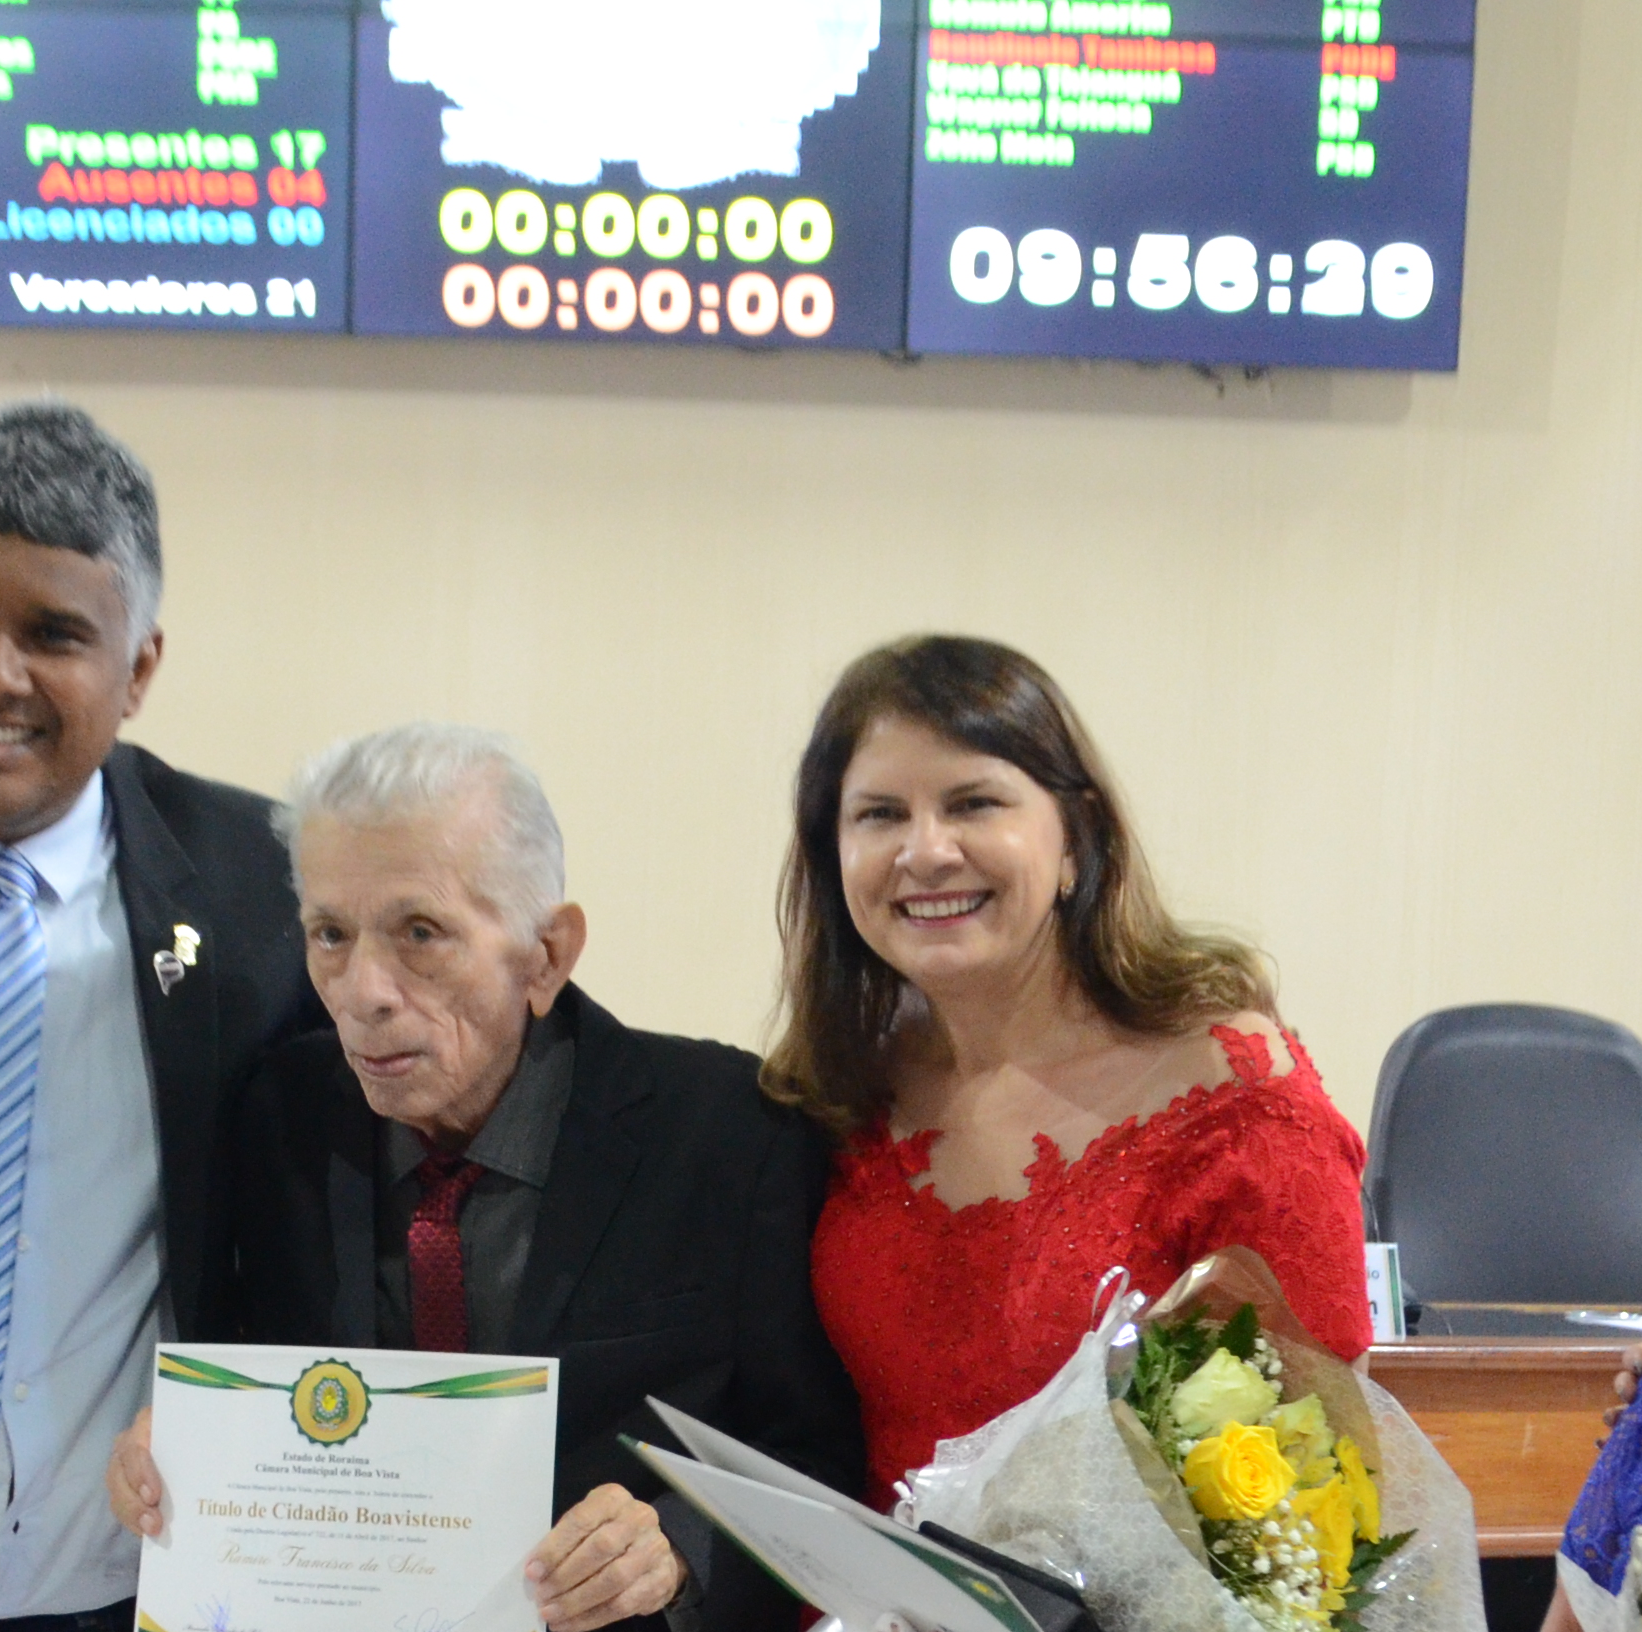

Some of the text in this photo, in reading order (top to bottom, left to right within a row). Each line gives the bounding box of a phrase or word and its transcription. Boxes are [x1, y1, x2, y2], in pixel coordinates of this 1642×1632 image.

[270, 128, 327, 170] 17
[267, 205, 325, 246] 00
[439, 188, 833, 264] 00:00:00
[266, 277, 316, 317] 21
[442, 263, 835, 338] 00:00:00
[282, 1452, 370, 1465] Estado de Roraima
[292, 1465, 338, 1477] Municipal
[340, 1468, 352, 1477] de
[354, 1468, 373, 1478] Boa
[375, 1469, 400, 1479] Vista
[197, 1498, 472, 1529] Título de Cidadão Boavistense
